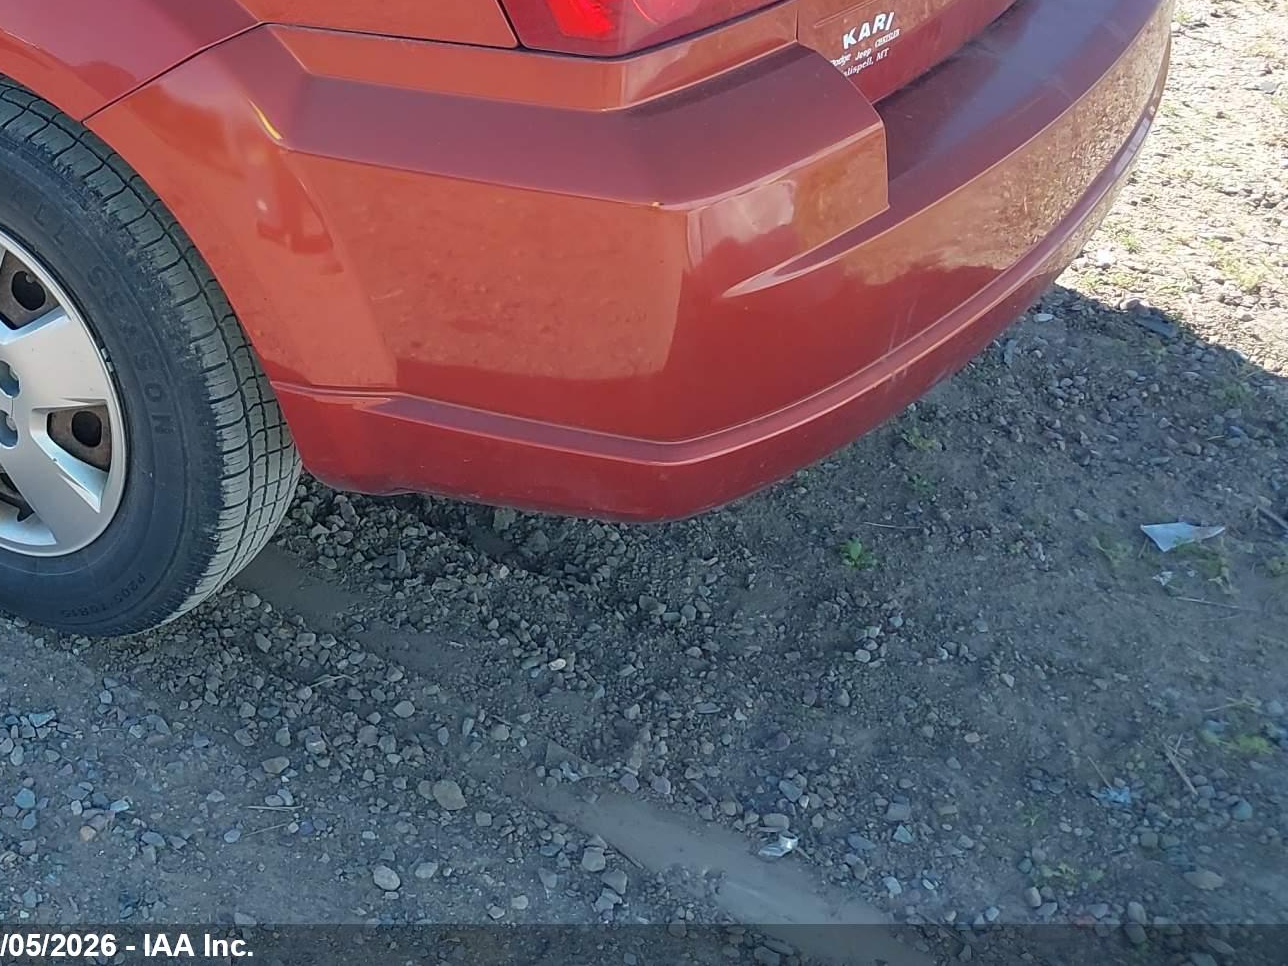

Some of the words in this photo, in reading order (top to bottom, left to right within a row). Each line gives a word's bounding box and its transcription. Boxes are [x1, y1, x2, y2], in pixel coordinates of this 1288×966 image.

[842, 11, 895, 50] KARI
[854, 47, 872, 61] Jeep
[875, 47, 890, 62] MT
